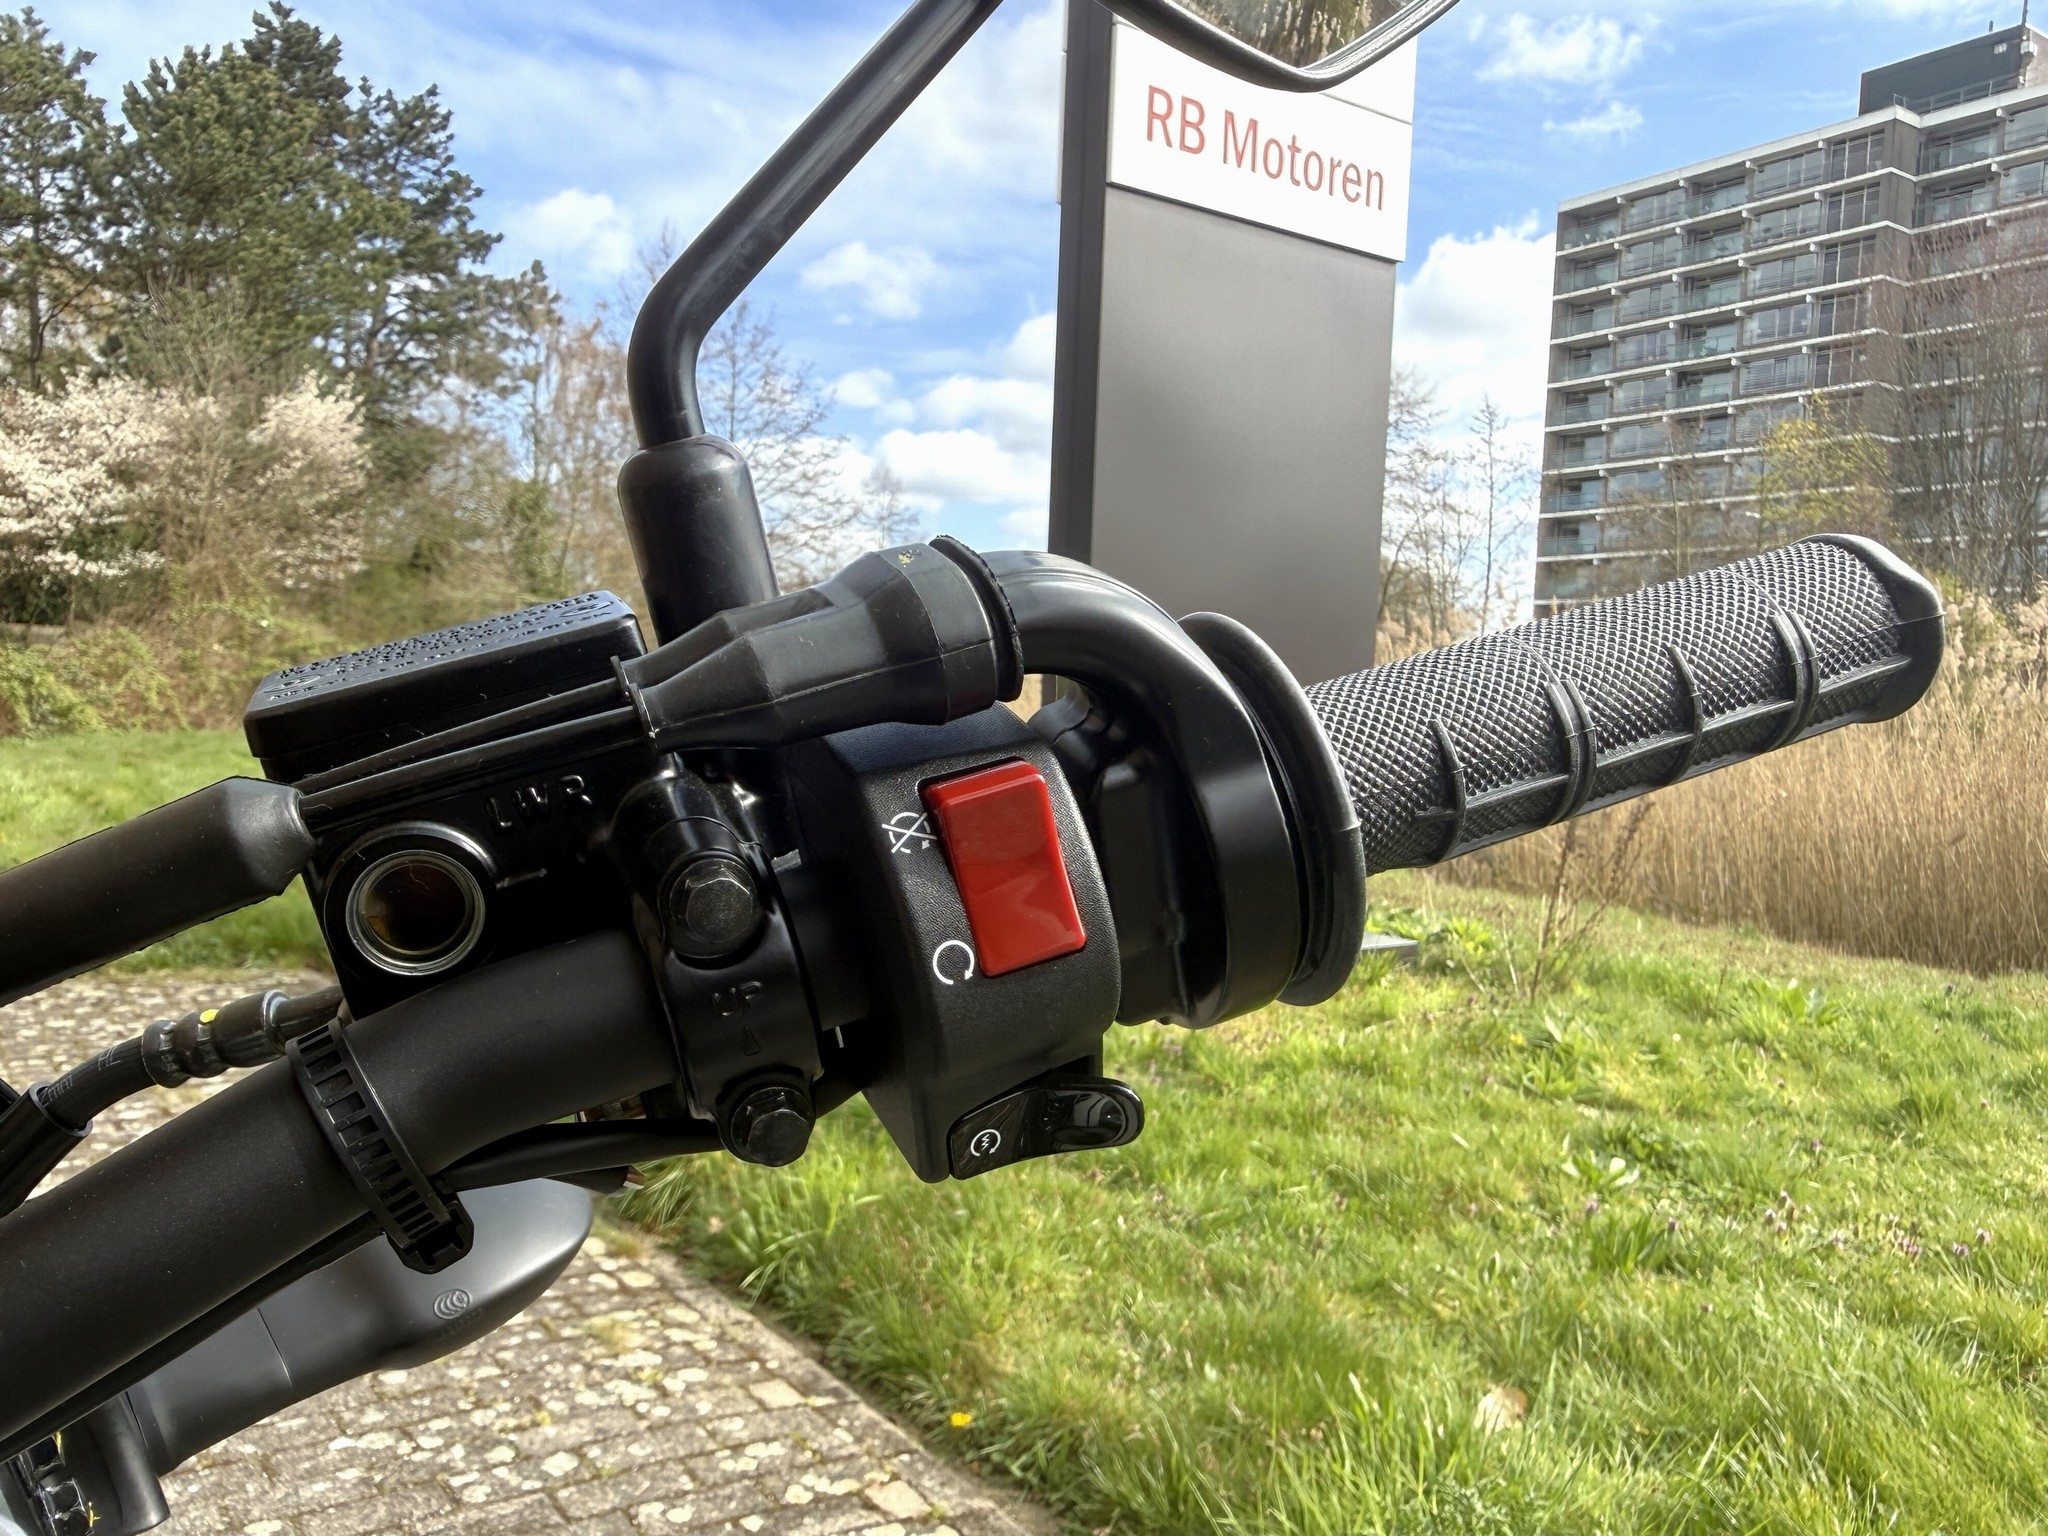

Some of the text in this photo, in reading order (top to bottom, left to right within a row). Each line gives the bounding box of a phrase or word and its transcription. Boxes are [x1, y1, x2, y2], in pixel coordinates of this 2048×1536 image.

[1146, 85, 1385, 211] RB Motoren
[711, 980, 762, 1017] UP
